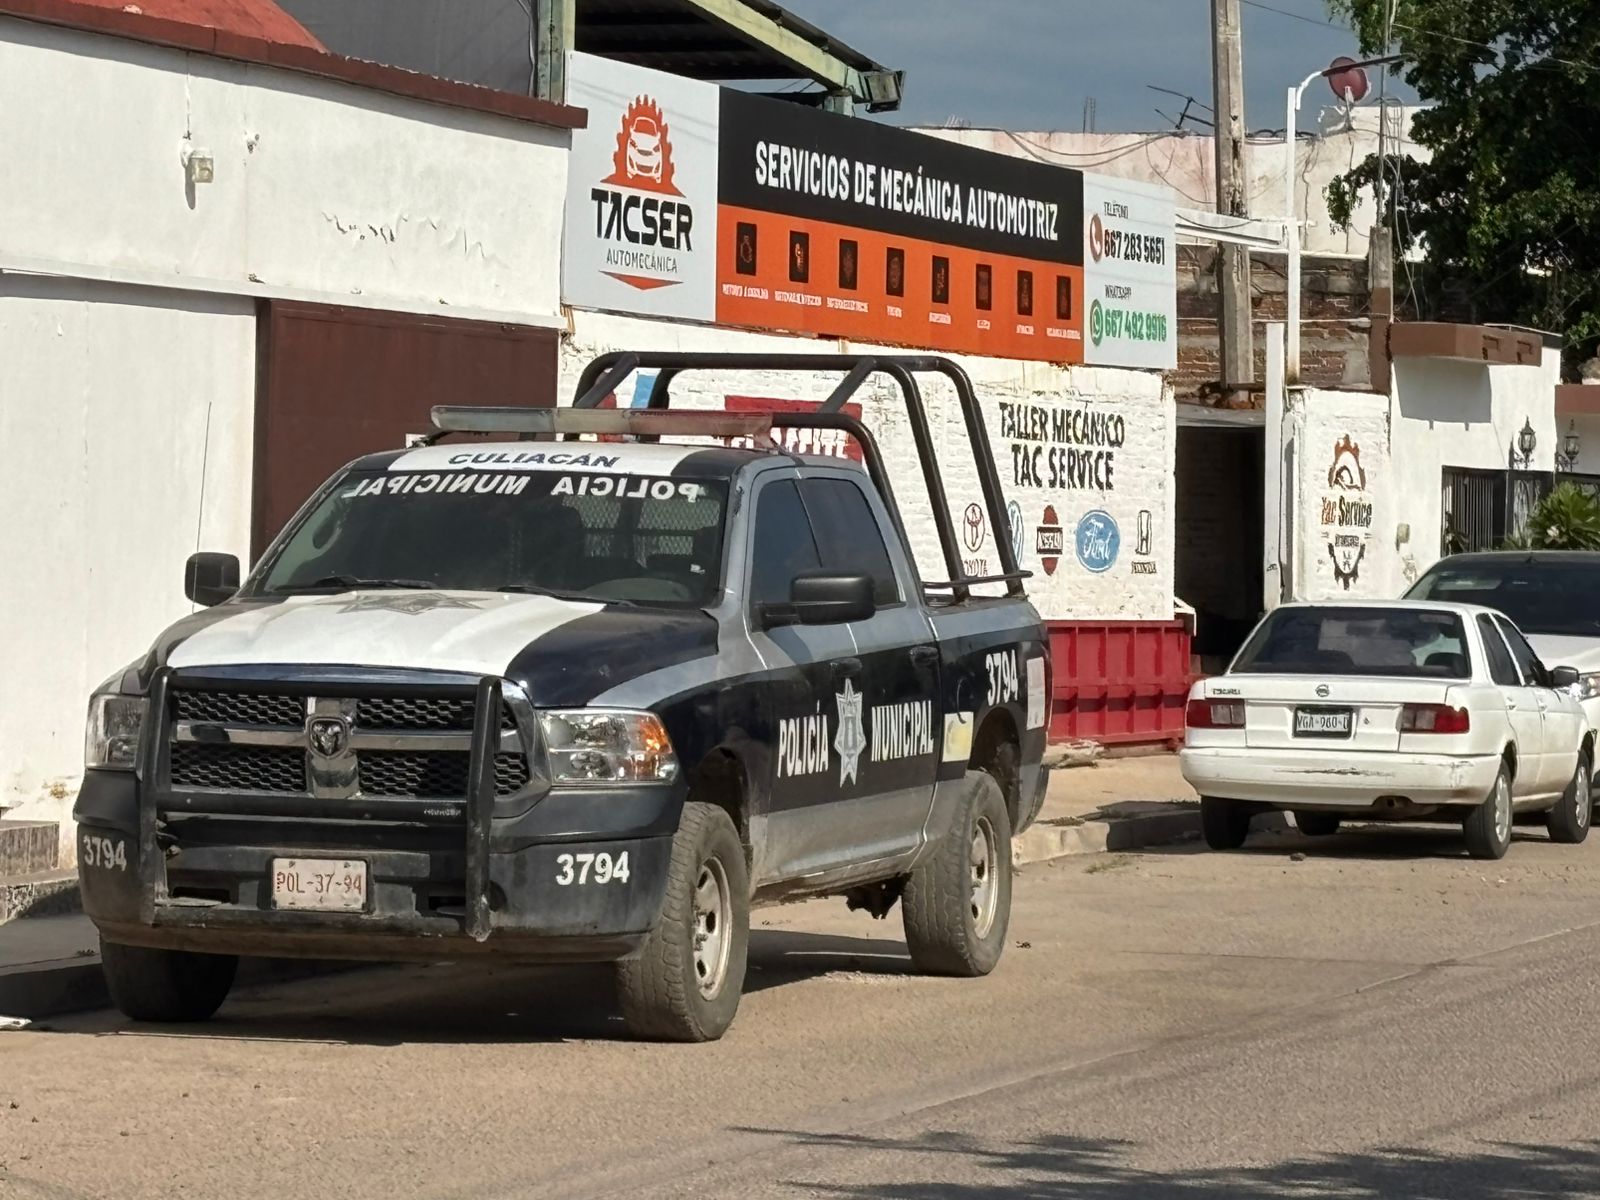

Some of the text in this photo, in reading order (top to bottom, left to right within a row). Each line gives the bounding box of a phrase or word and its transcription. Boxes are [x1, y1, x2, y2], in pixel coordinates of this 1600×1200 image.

[755, 140, 1058, 241] SERVICIOS DE MECÁNICA AUTOMOTRIZ
[591, 188, 693, 252] TACSER
[606, 248, 678, 273] AUTOMECÁNICA
[1104, 308, 1167, 342] 667 492 9916
[999, 402, 1049, 442] TALLER
[448, 453, 621, 468] CULIACÁN
[1011, 444, 1115, 491] TAC SERVICE
[985, 649, 1019, 706] 3794
[777, 700, 934, 778] POLICÍA MUNICIPAL
[83, 835, 127, 871] 3794
[556, 851, 630, 885] 3794
[276, 872, 362, 895] POL-37-94
